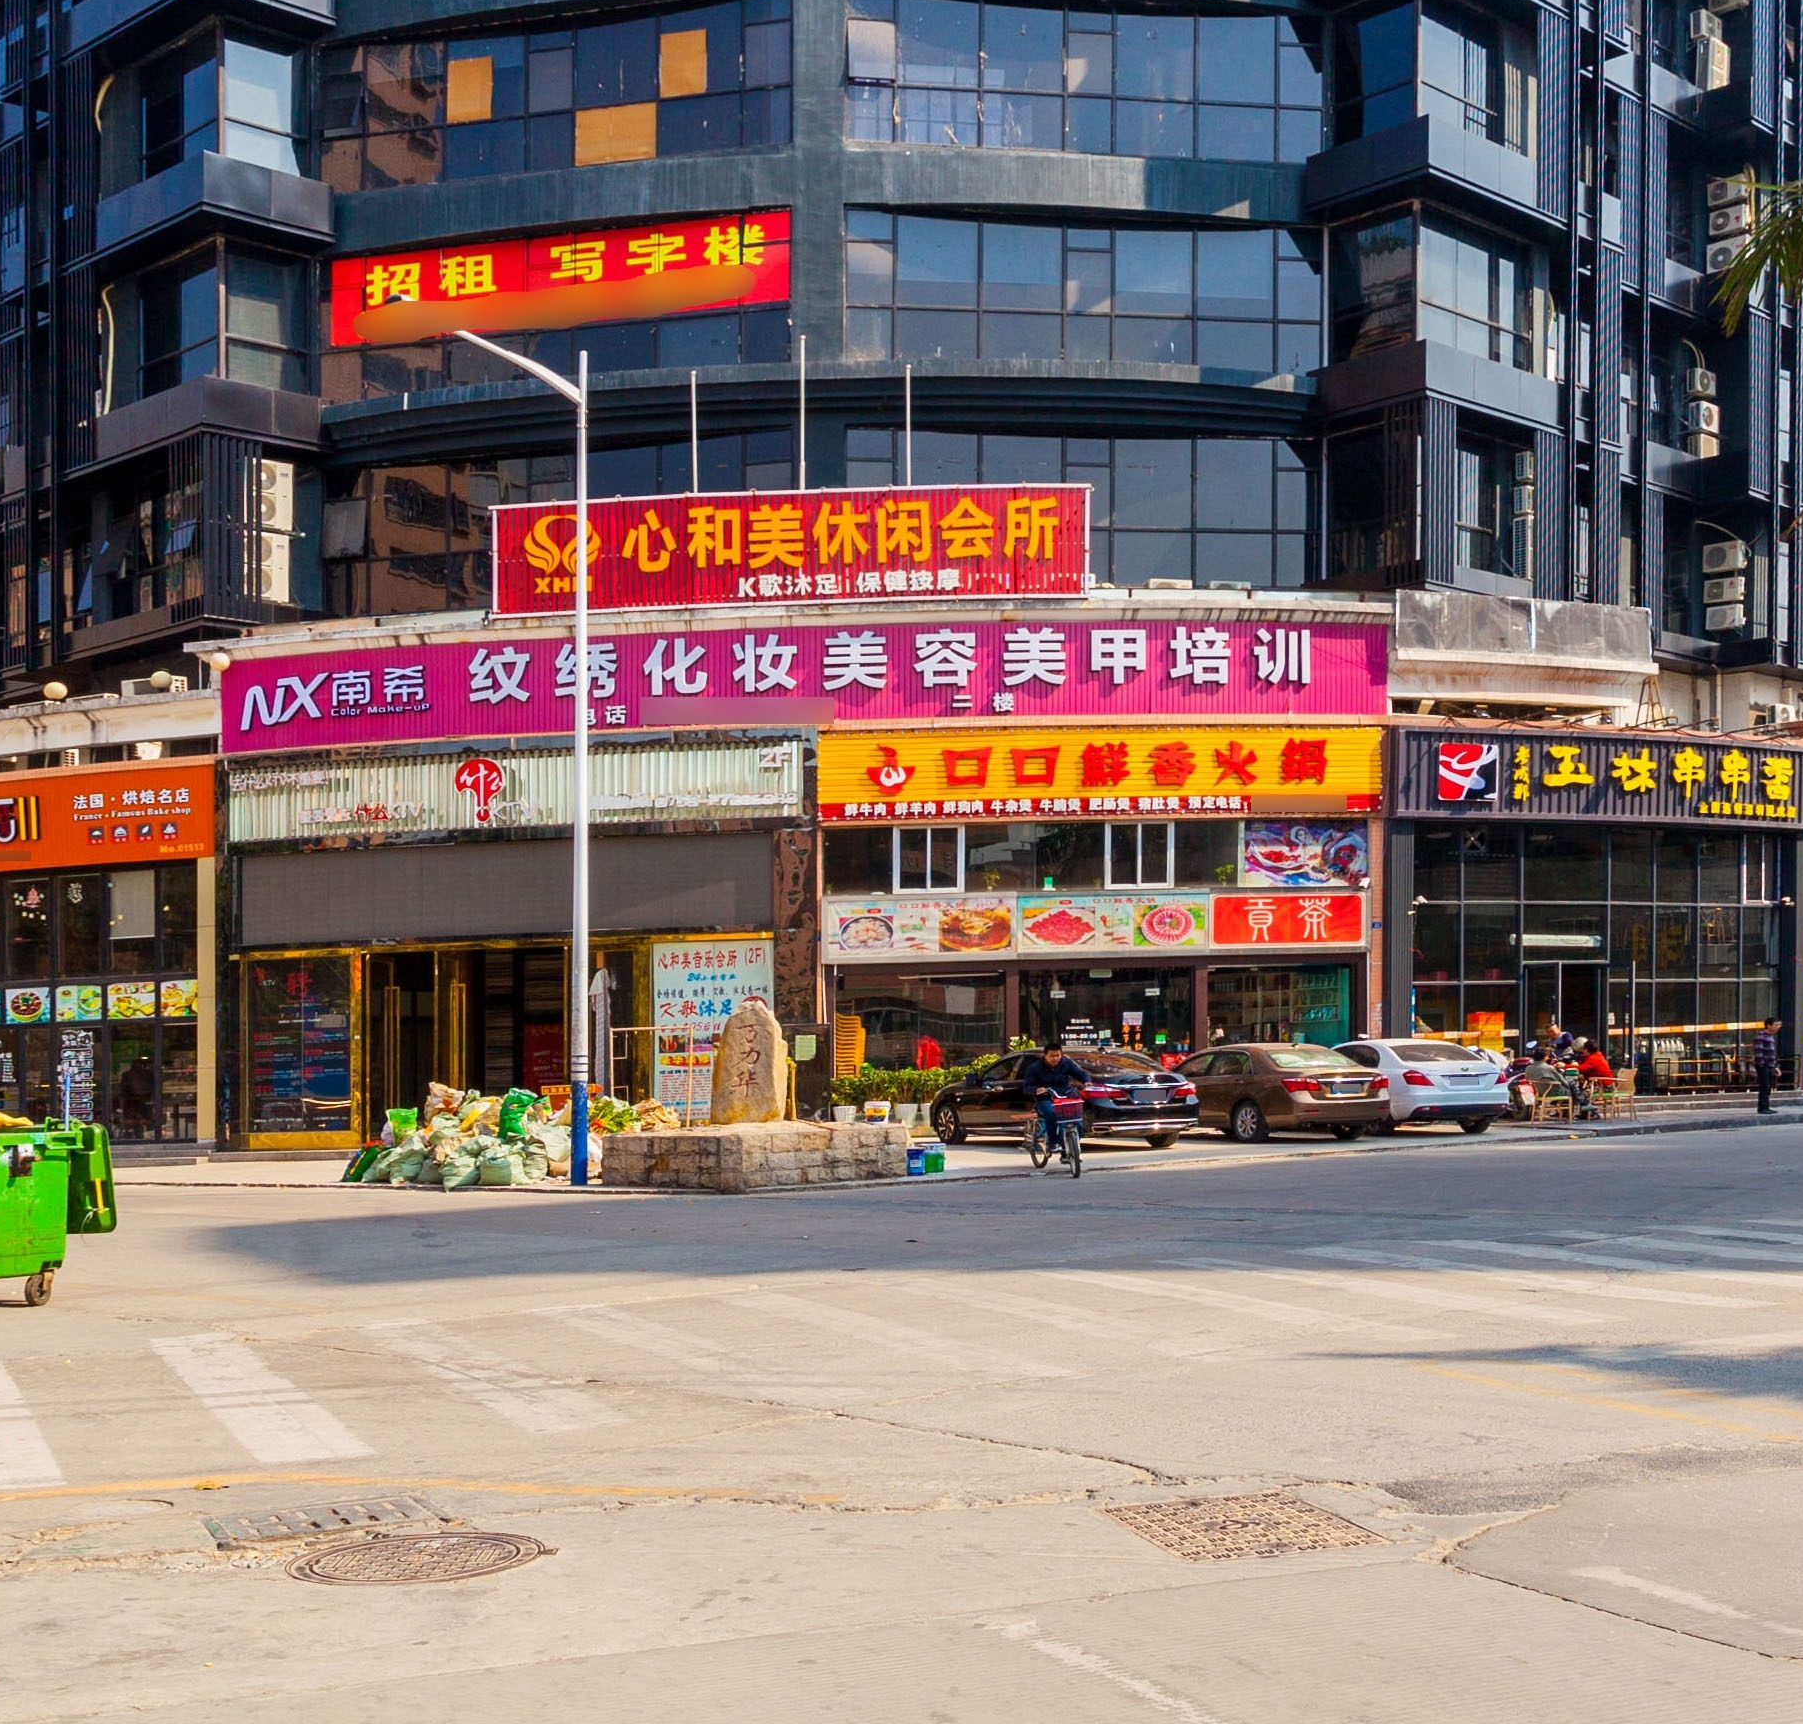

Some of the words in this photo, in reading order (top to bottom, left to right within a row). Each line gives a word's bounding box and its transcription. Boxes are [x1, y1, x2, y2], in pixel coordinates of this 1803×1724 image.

[366, 252, 496, 307] 招租
[551, 224, 765, 283] 写字楼
[623, 496, 1059, 573] 心和美休闲会所
[331, 666, 426, 706] 南希
[469, 627, 1312, 704] 纹绣化妆美容美甲培训
[760, 747, 791, 767] 2F
[1543, 744, 1794, 801] 玉林串串香
[658, 949, 737, 970] 心和美音乐会所
